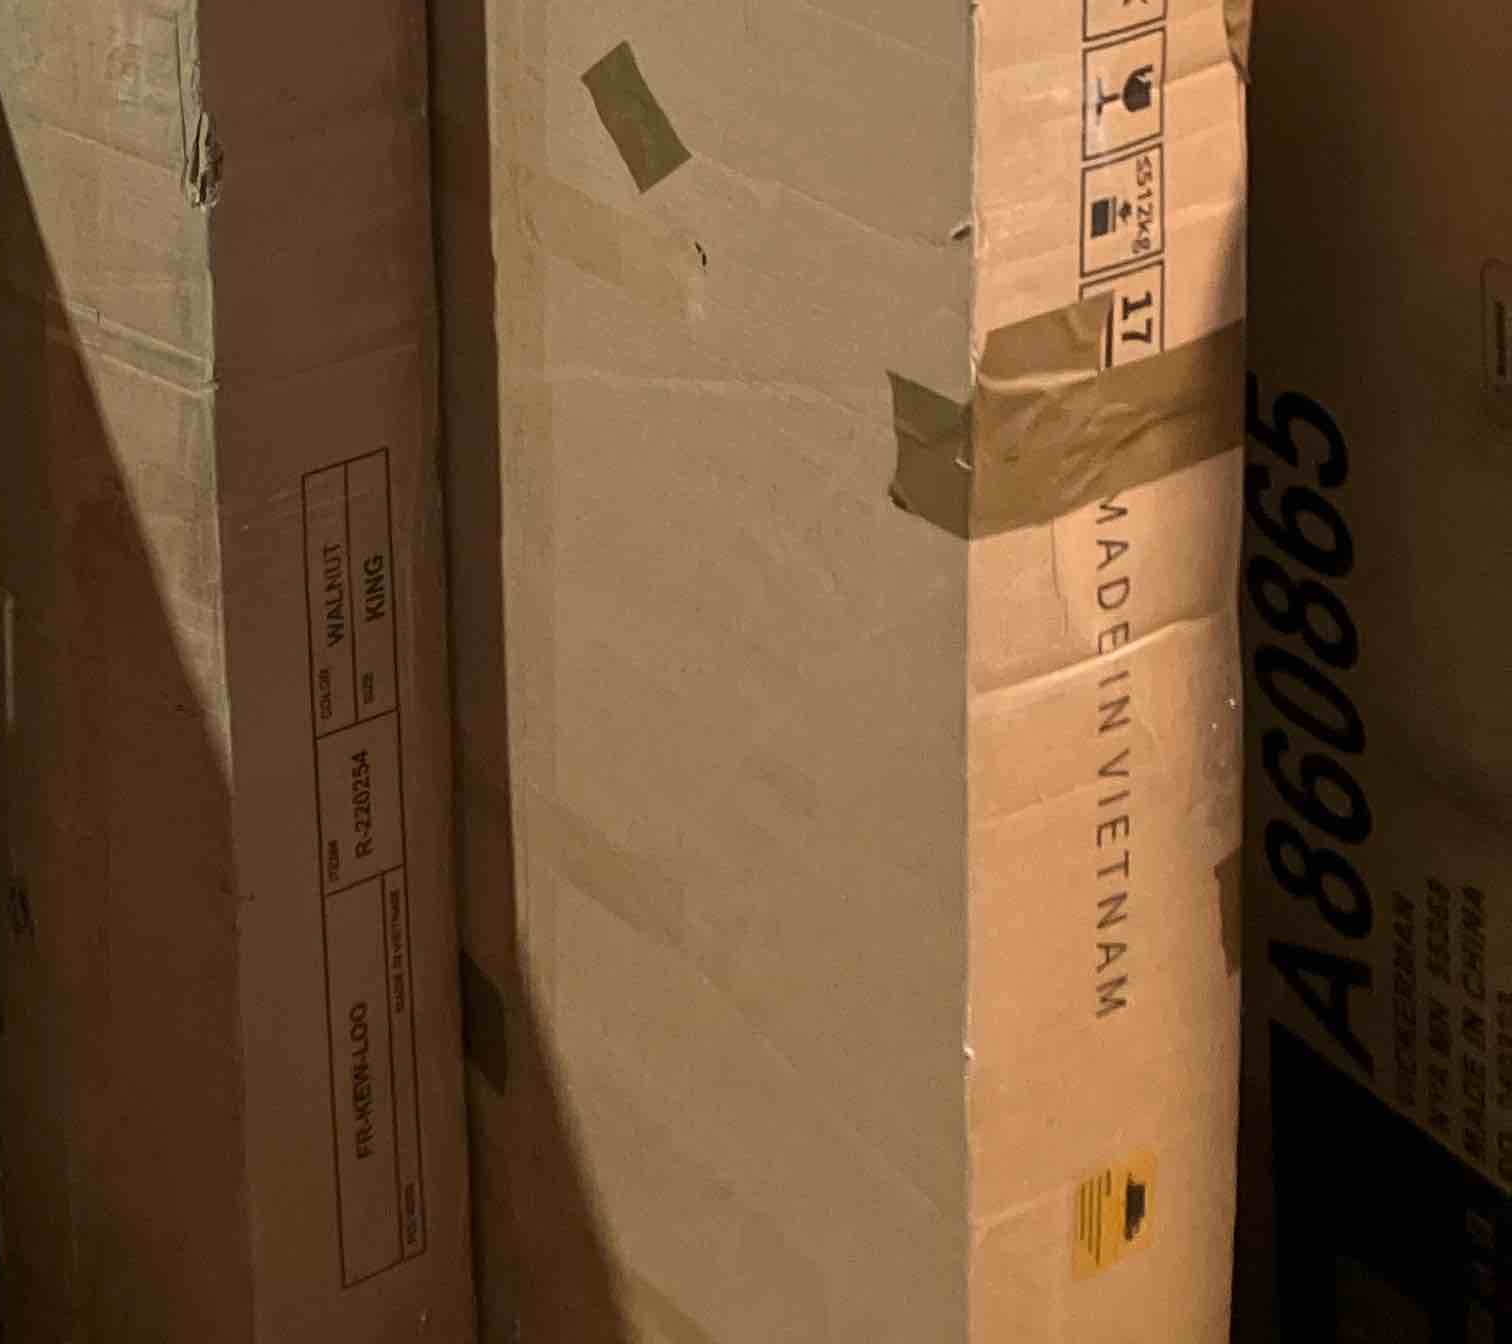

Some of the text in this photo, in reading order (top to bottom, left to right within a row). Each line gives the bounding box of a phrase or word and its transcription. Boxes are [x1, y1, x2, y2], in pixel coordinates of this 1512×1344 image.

[324, 543, 346, 648] WALNUT
[363, 554, 386, 623] KING
[1097, 670, 1131, 736] IN
[1242, 367, 1375, 1080] A860865
[1095, 748, 1131, 1019] VIETNAM
